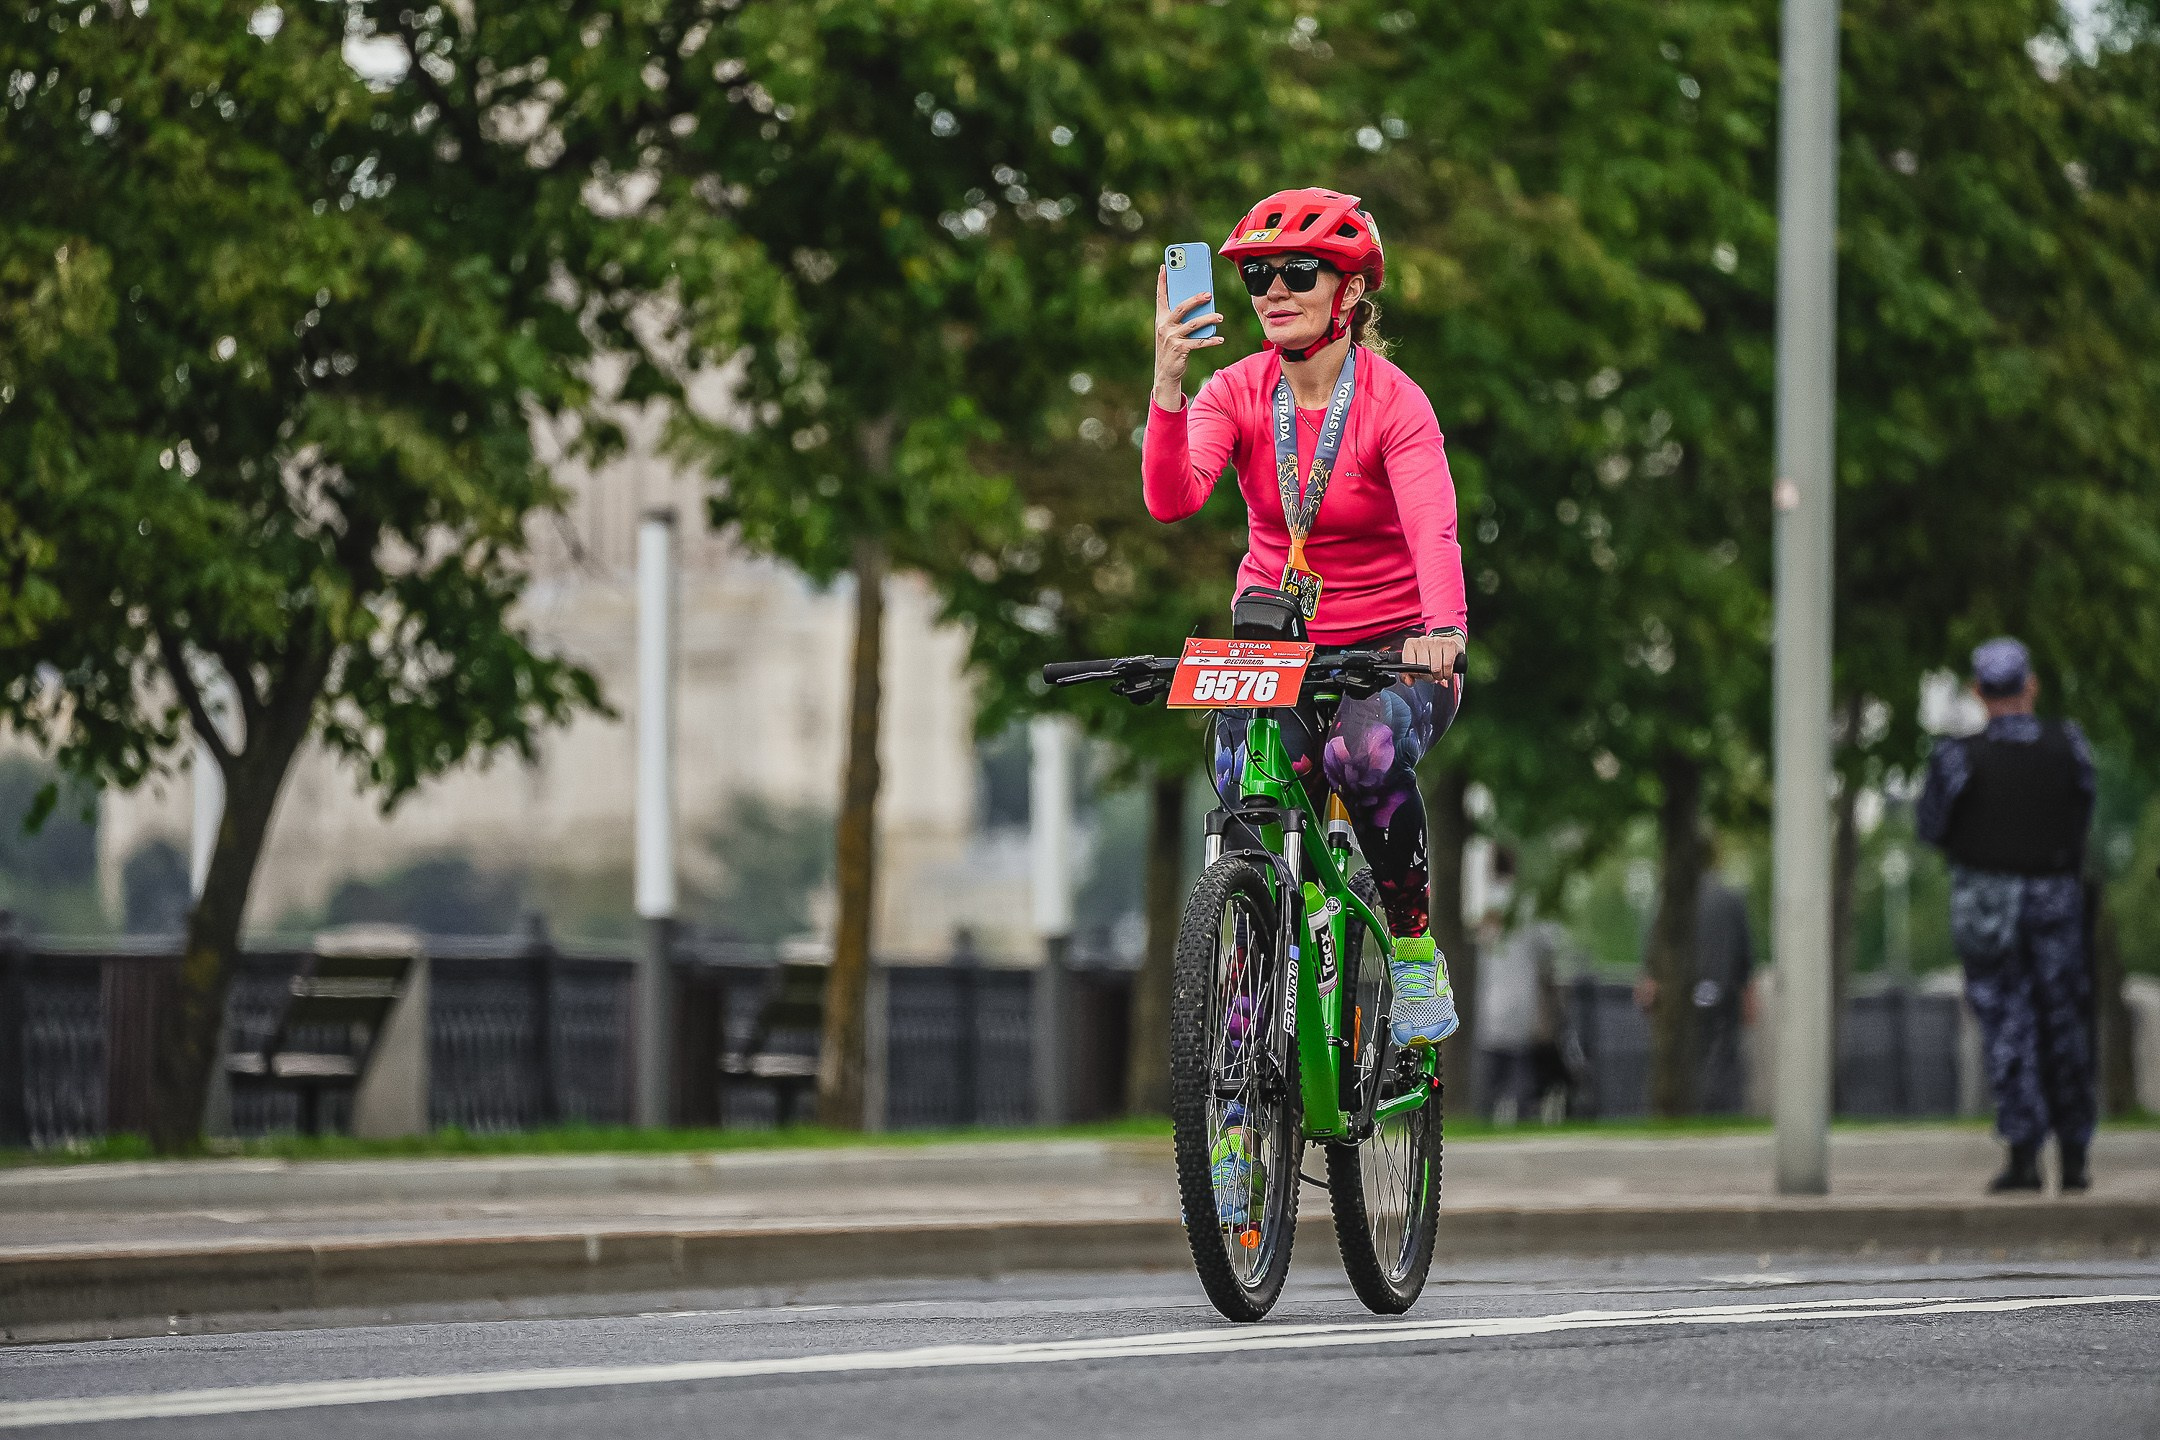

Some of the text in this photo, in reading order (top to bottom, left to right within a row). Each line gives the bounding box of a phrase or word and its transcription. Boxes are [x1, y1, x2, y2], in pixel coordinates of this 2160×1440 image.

[1277, 391, 1291, 442] STRADA
[1324, 381, 1353, 448] LA STRADA
[1285, 583, 1299, 596] 40
[1223, 658, 1265, 666] ФЕСТИВАЛЬ
[1239, 642, 1272, 650] STRADA
[1192, 669, 1280, 702] 5576
[1321, 930, 1334, 977] Tacx
